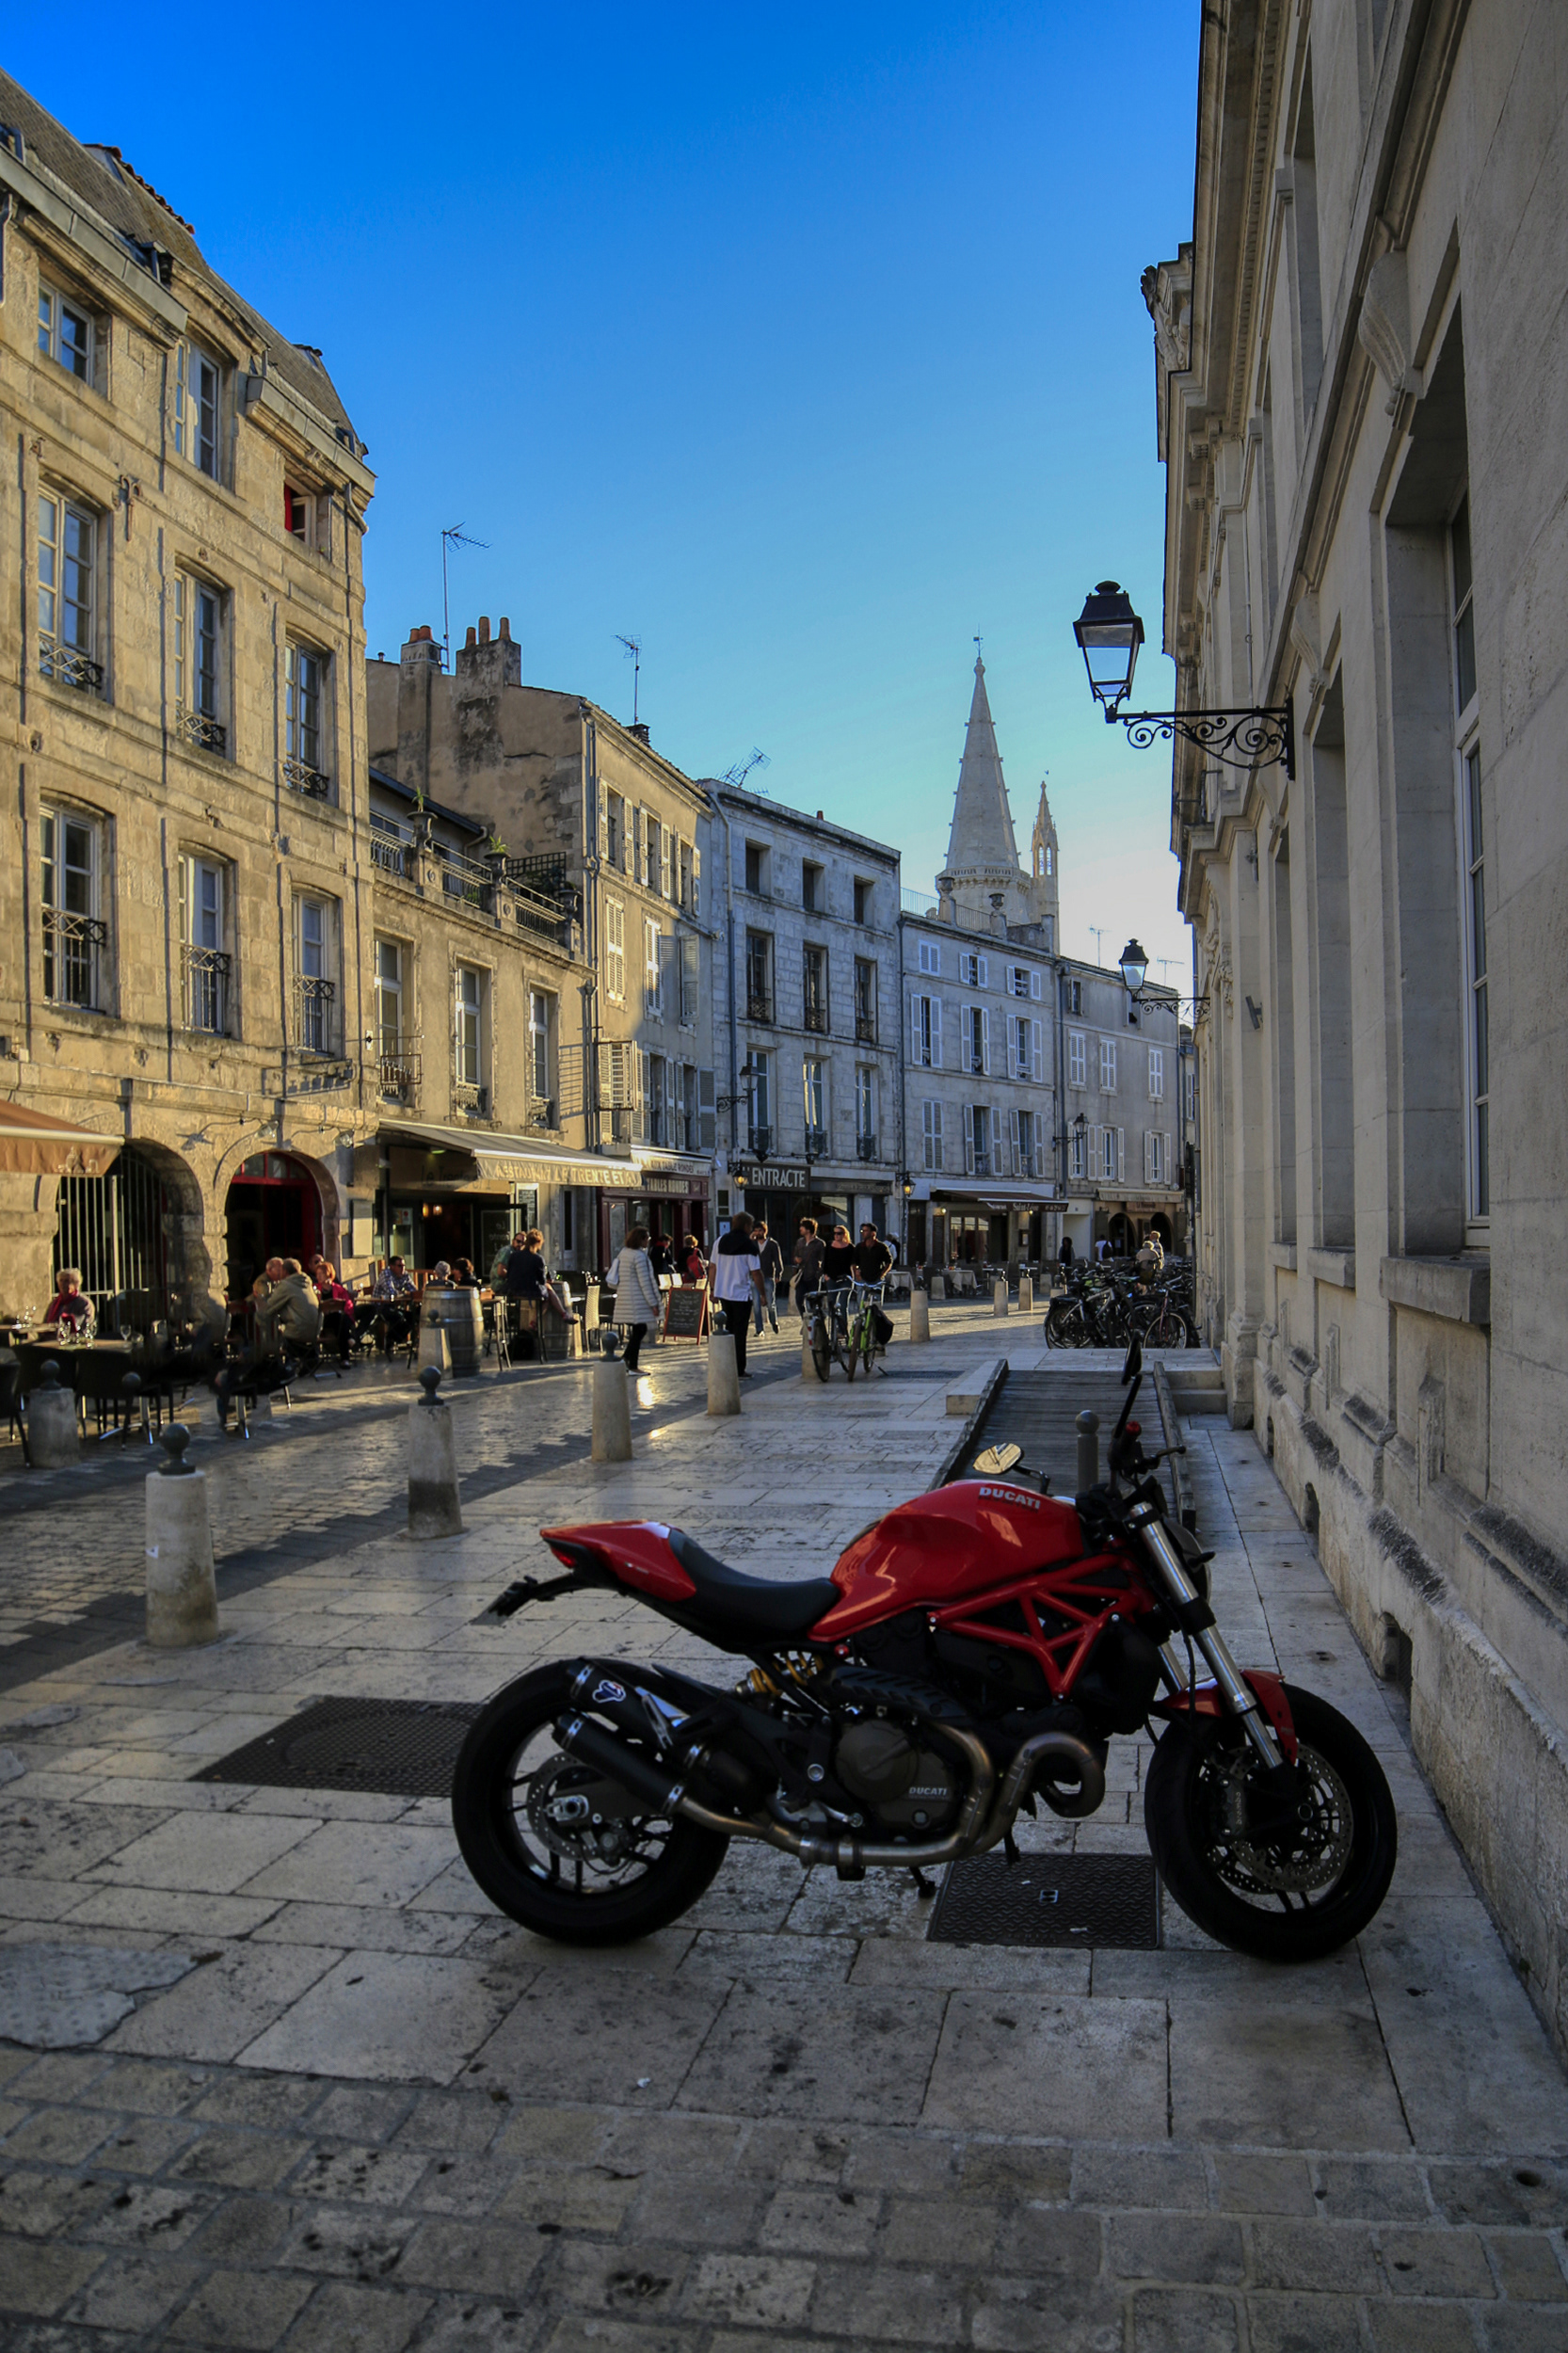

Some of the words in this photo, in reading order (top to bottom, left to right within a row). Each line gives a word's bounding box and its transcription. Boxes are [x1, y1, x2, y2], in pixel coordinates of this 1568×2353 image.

[572, 1167, 611, 1185] TRENTE
[979, 1486, 1042, 1510] DUCATI
[908, 1786, 948, 1796] DUCATI
